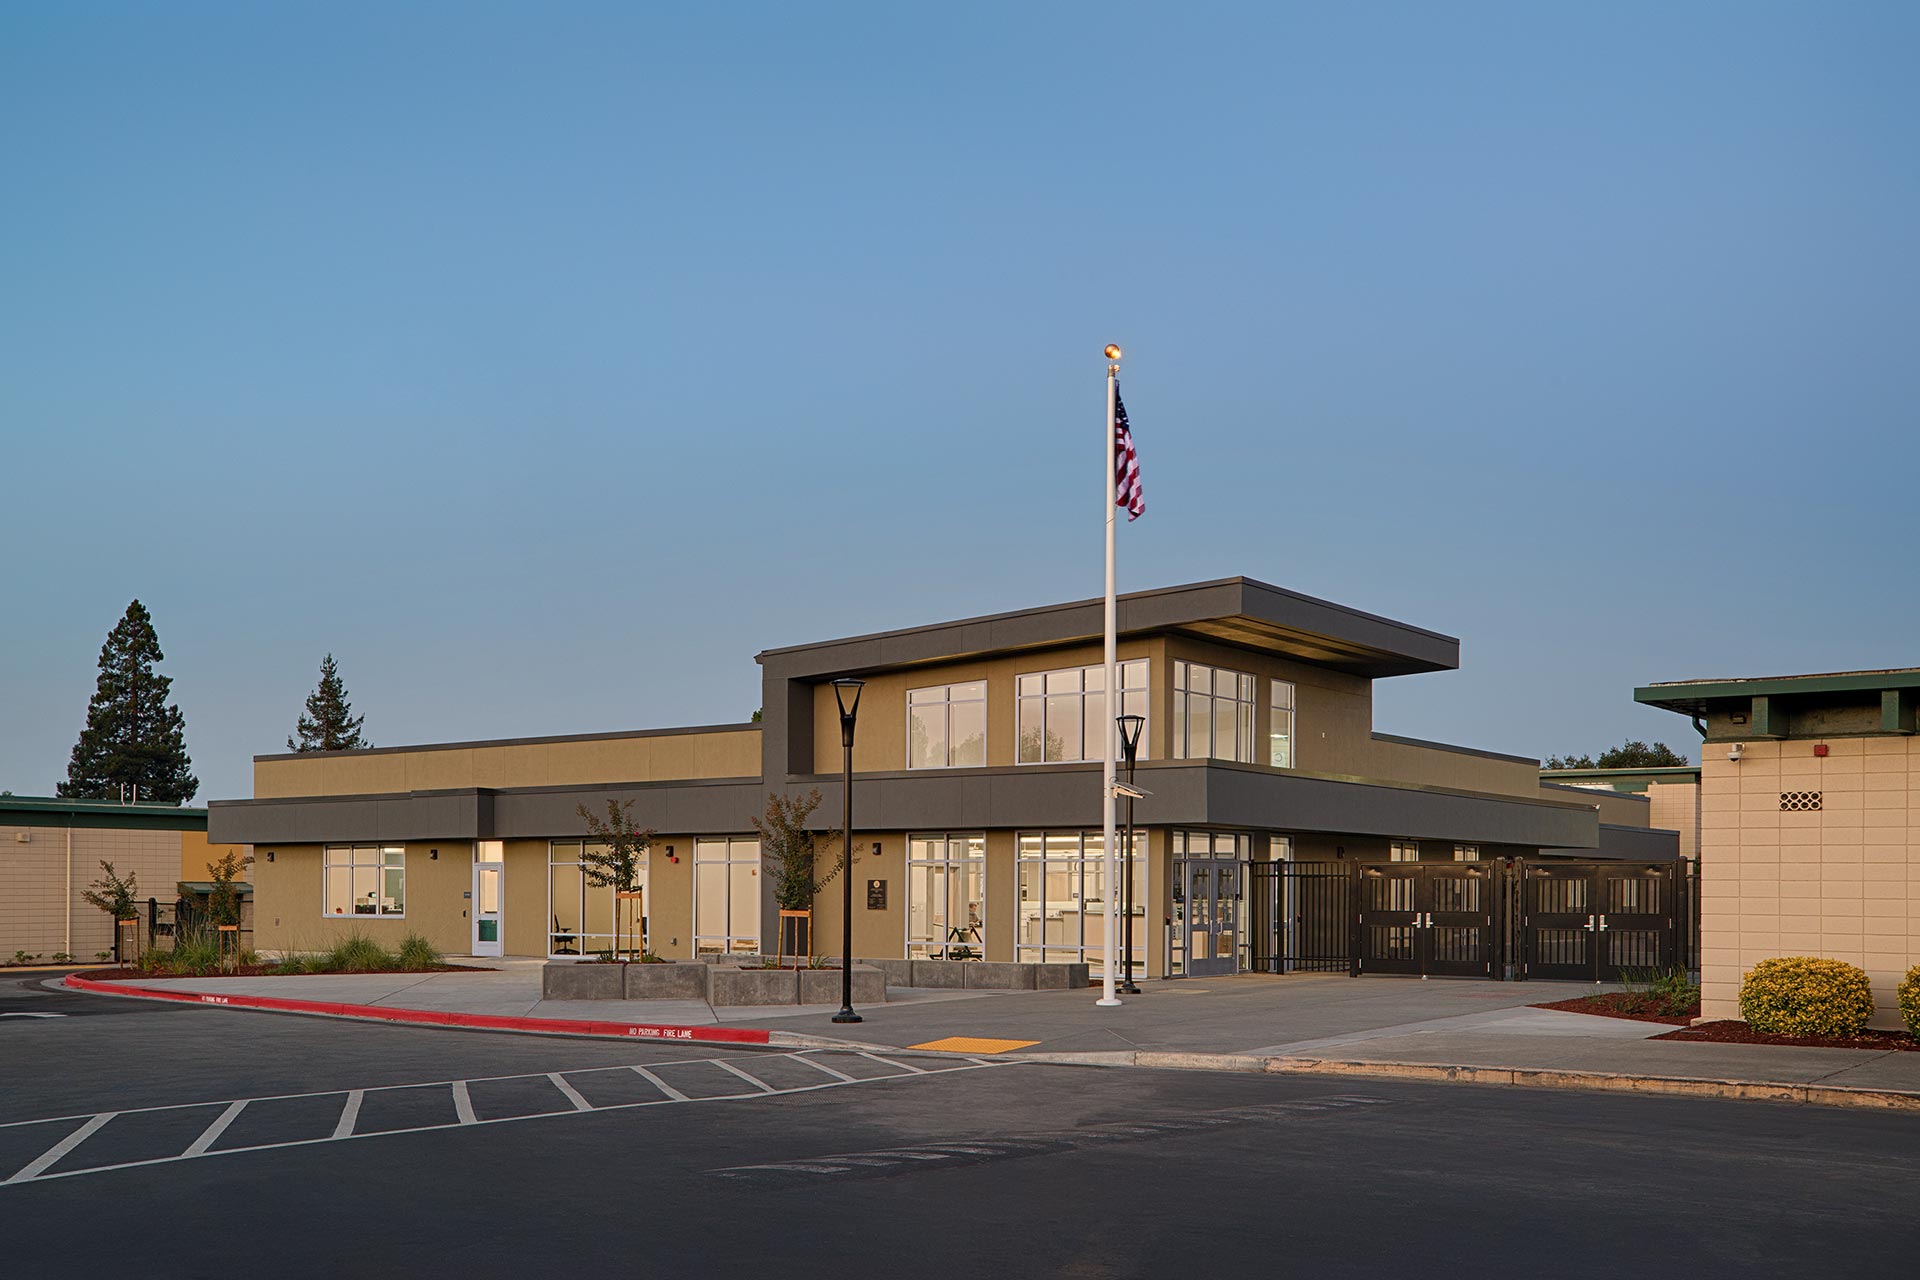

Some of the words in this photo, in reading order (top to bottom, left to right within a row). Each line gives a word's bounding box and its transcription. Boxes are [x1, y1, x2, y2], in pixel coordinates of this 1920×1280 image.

[638, 1028, 660, 1036] PARKING
[663, 1029, 676, 1038] FIRE
[677, 1030, 692, 1038] LANE
